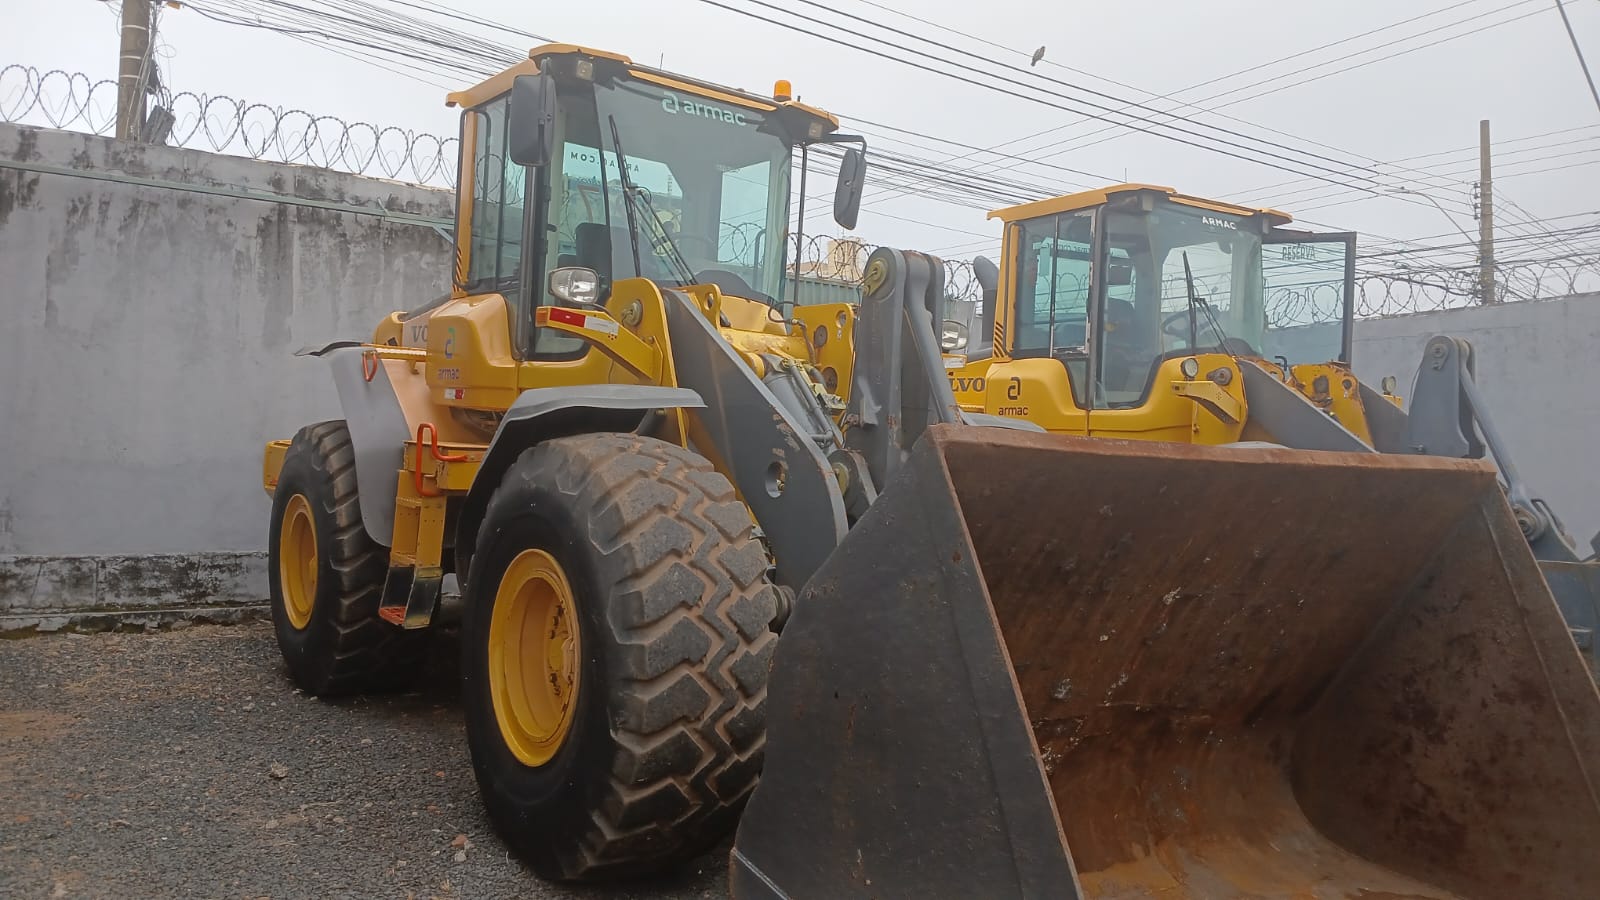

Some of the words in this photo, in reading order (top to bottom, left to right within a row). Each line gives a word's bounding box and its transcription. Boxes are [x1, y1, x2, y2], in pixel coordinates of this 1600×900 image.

[683, 100, 746, 127] armac
[1202, 215, 1237, 230] ARMAC
[998, 405, 1029, 416] armac
